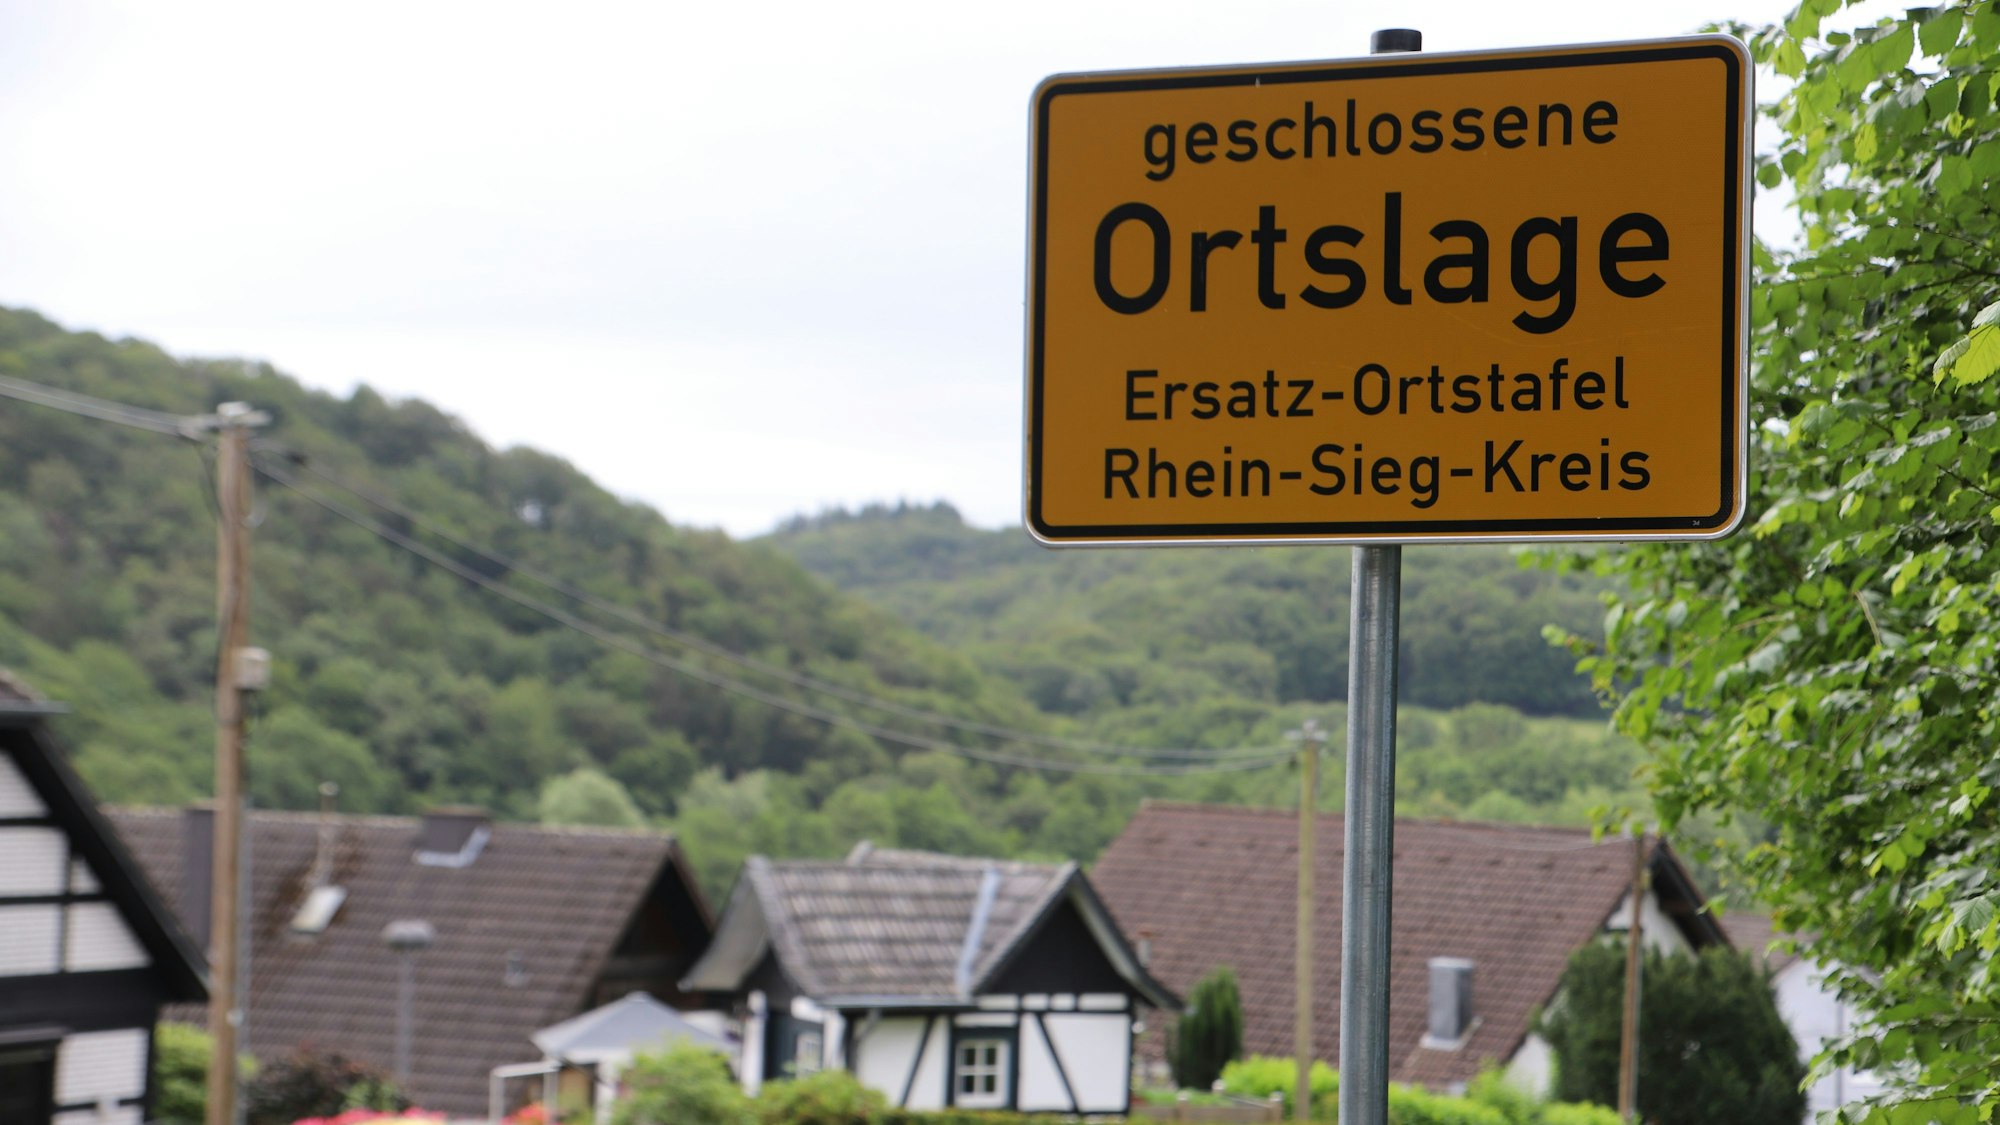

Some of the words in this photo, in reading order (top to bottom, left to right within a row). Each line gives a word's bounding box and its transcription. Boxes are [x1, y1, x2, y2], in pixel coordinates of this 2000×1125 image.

[1144, 98, 1618, 181] geschlossene
[1093, 191, 1670, 335] Ortslage
[1125, 355, 1629, 421] Ersatz-Ortstafel
[1104, 437, 1651, 509] Rhein-Sieg-Kreis
